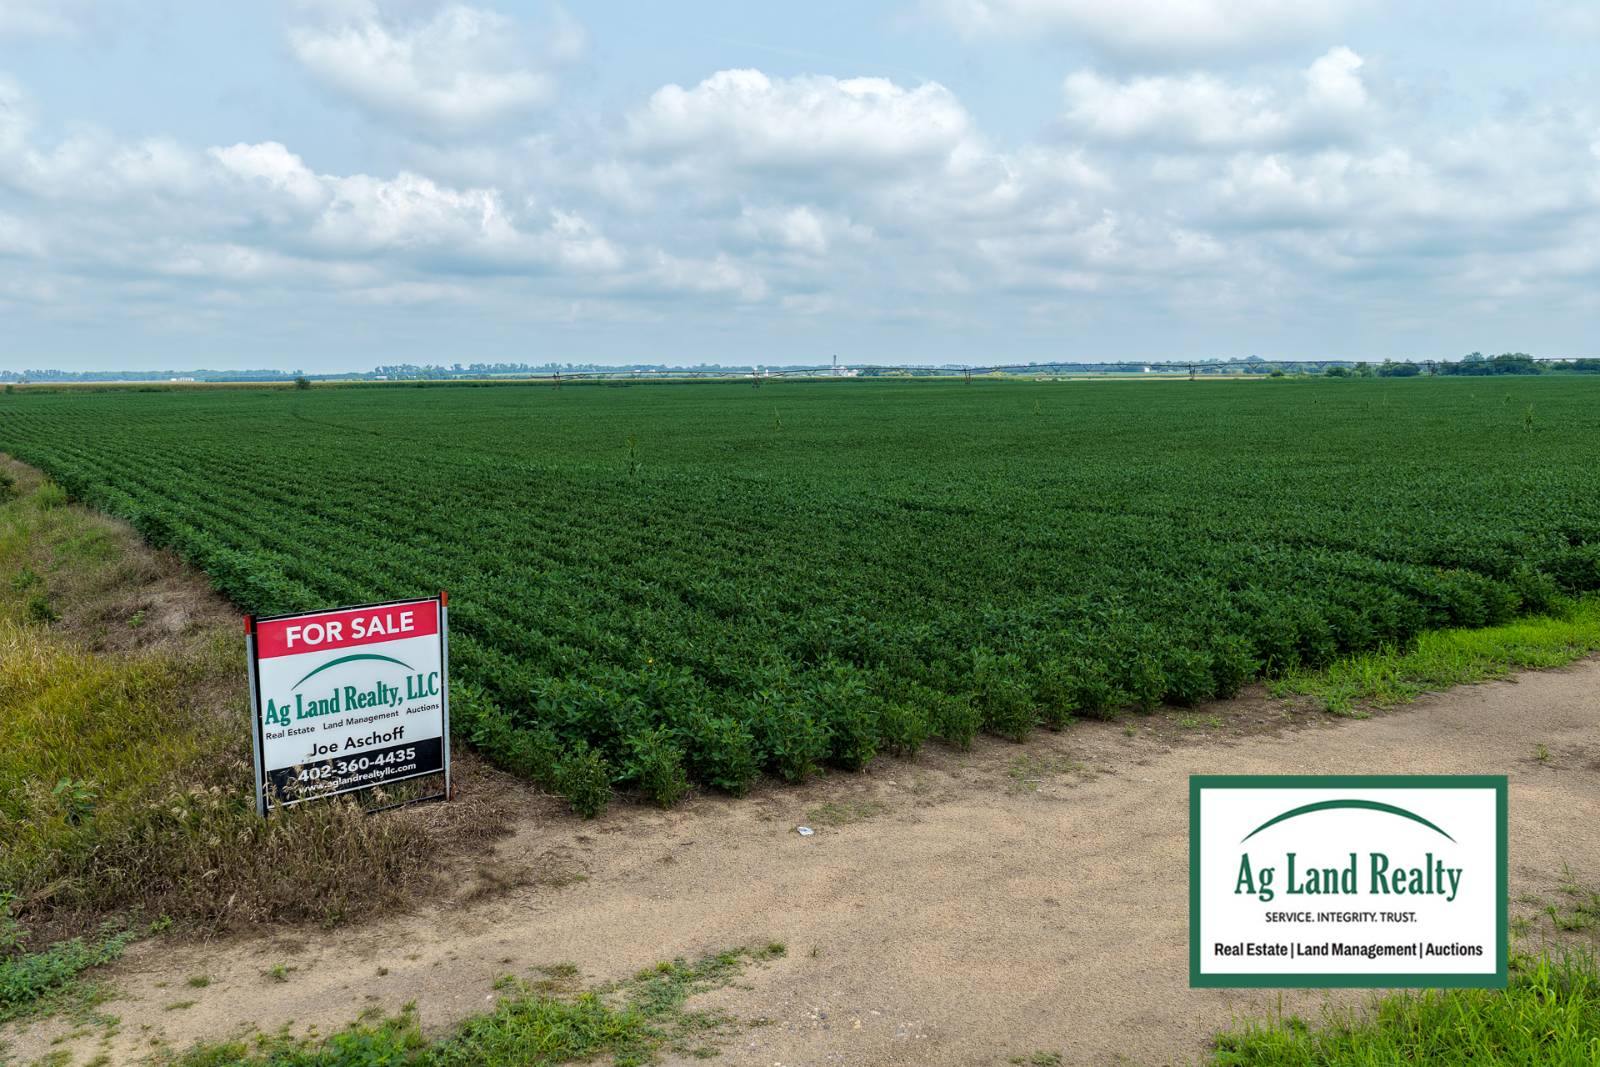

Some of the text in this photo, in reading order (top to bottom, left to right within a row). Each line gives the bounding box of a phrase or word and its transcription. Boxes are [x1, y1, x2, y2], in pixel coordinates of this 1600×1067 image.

[287, 611, 414, 648] FOR SALE
[265, 672, 439, 726] Ag Land Realty, LLC
[266, 703, 439, 740] Real Estate Land Management Auctions
[310, 726, 404, 756] Joe Aschoff
[298, 748, 416, 782] 402-360-4435
[299, 762, 416, 793] www.glandrealtyllc.com
